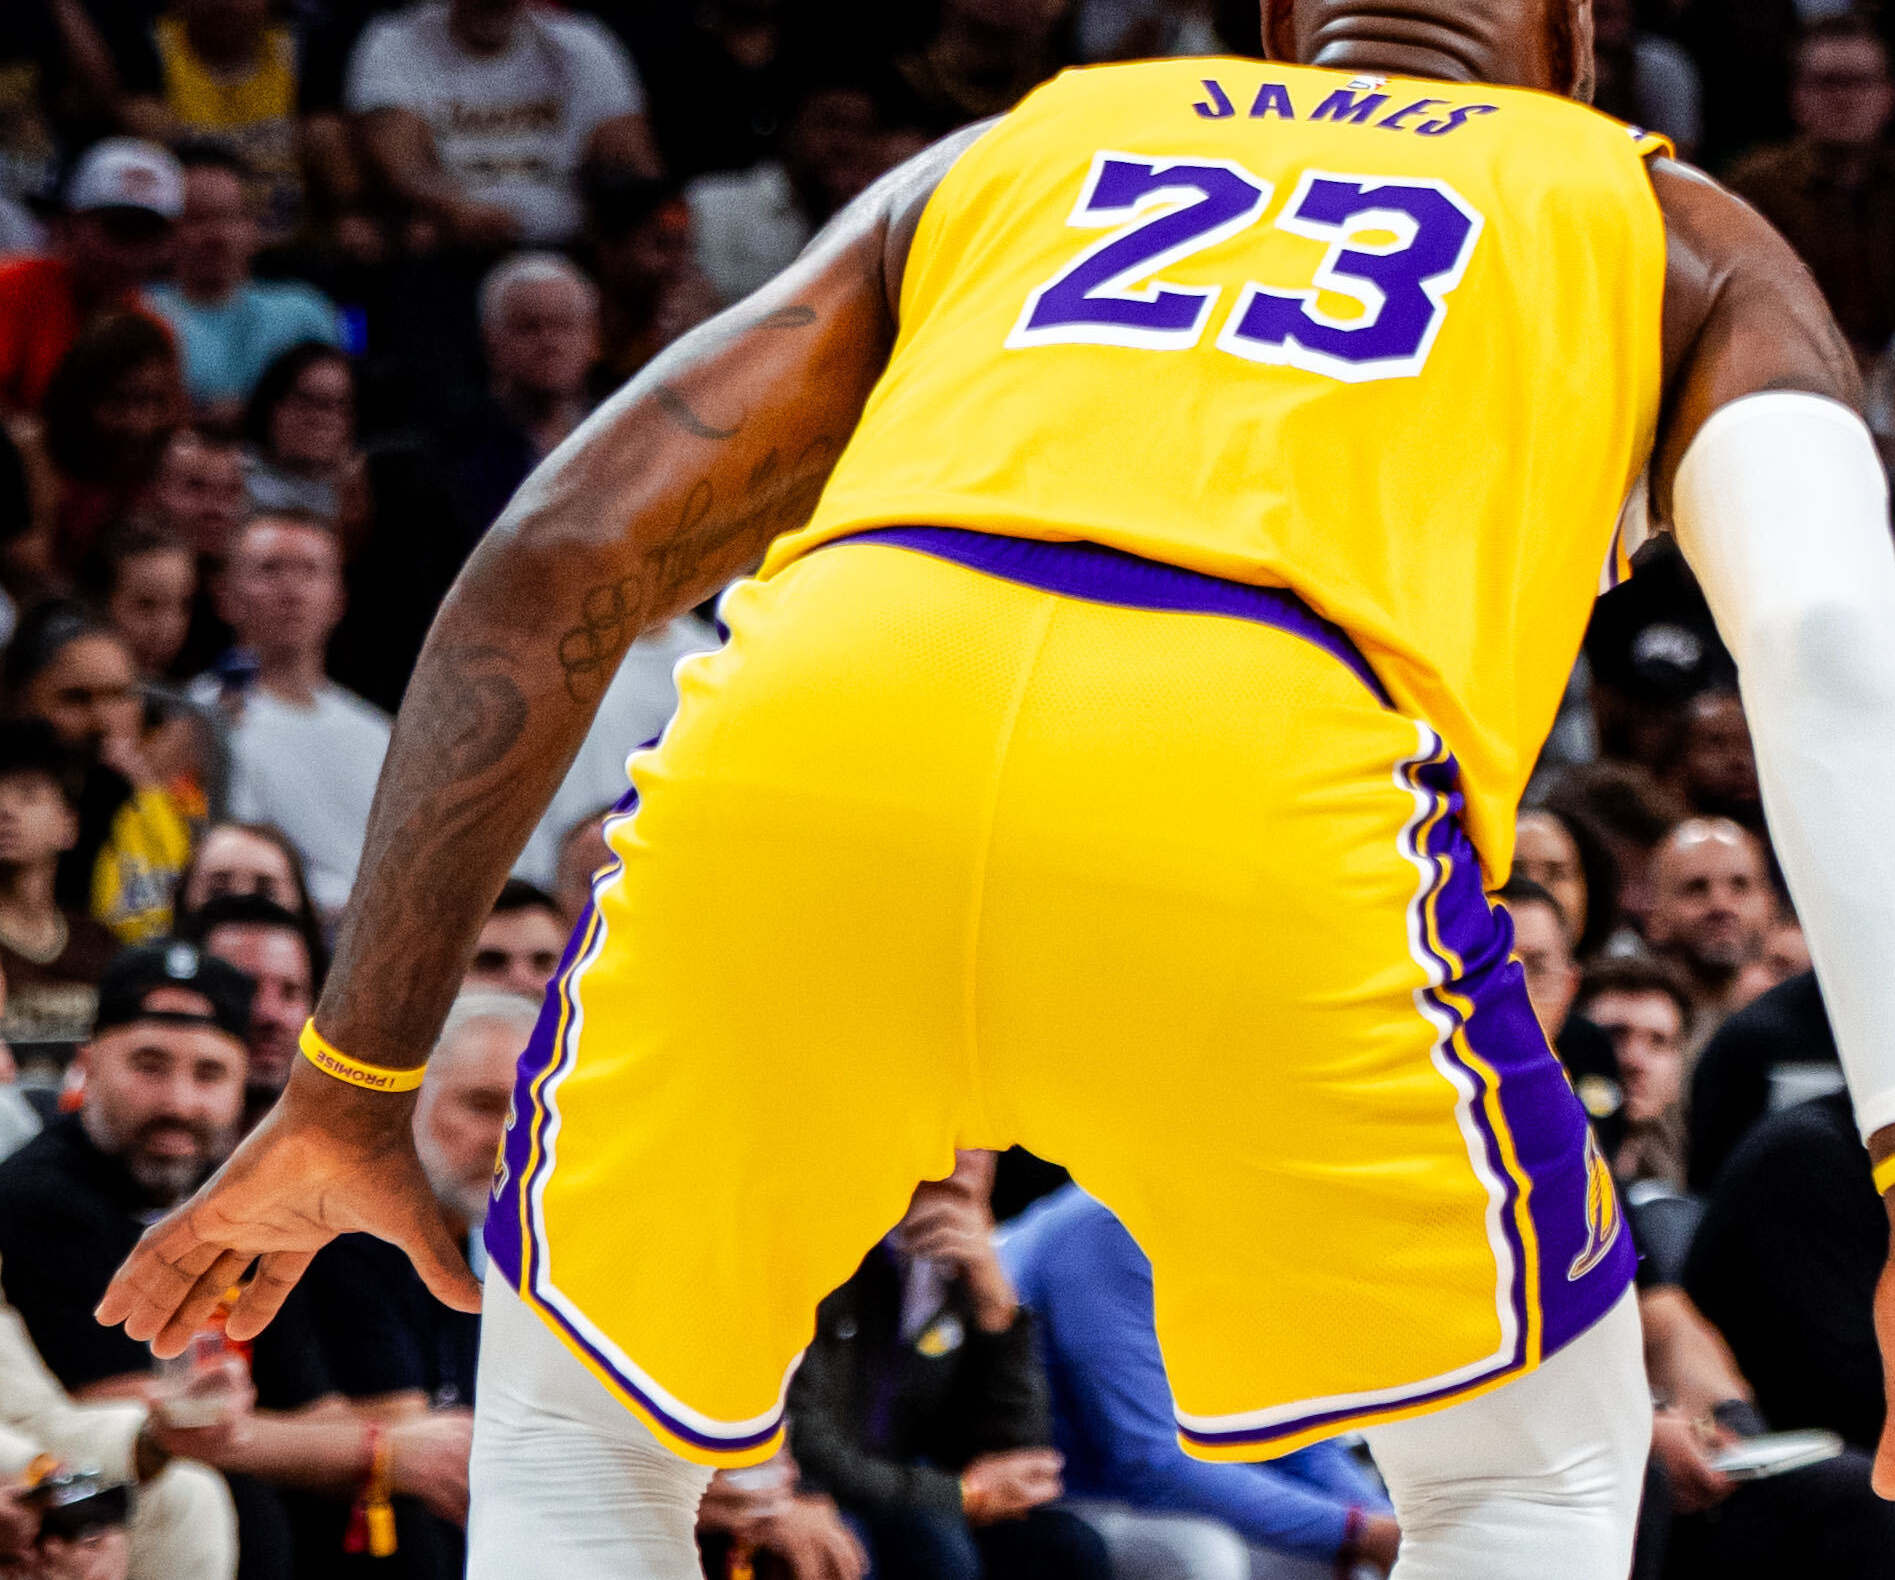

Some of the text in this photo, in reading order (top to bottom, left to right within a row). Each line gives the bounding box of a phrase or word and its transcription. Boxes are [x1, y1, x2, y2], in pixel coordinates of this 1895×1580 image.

[1192, 79, 1500, 137] JAMES
[1003, 149, 1484, 384] 23
[315, 1049, 387, 1089] PROMISE
